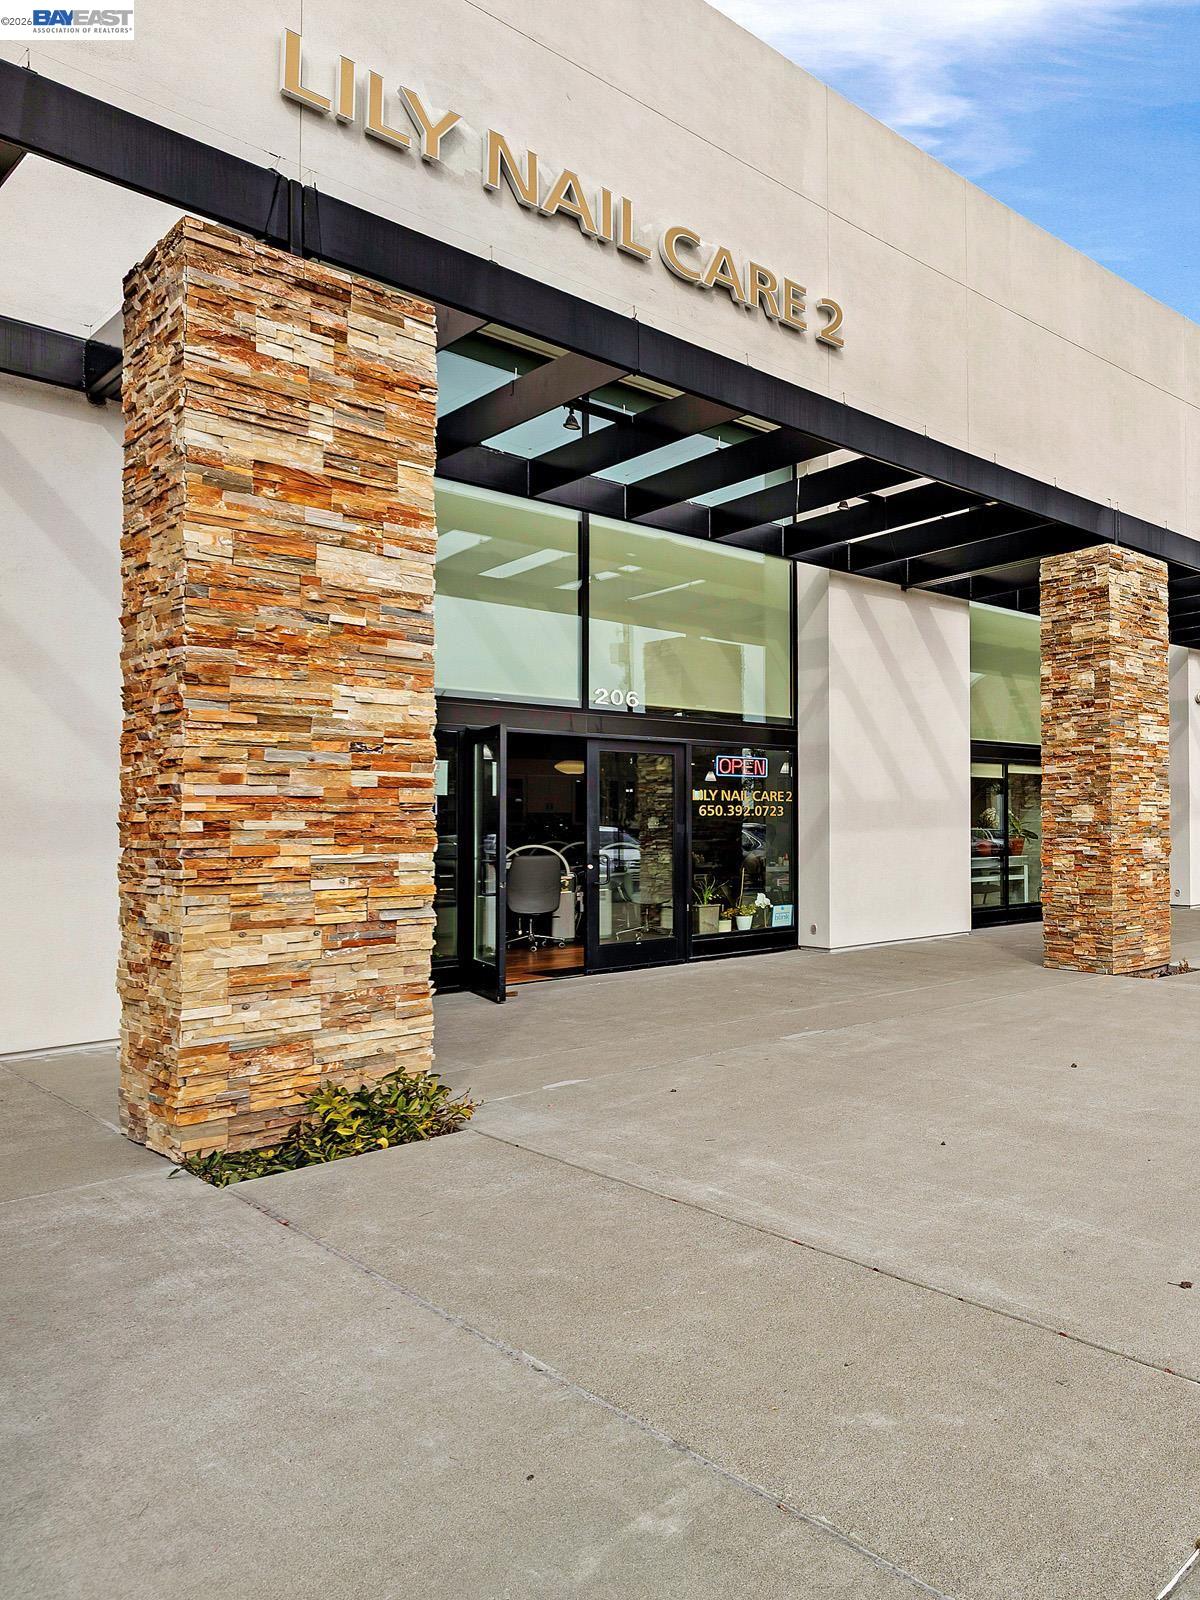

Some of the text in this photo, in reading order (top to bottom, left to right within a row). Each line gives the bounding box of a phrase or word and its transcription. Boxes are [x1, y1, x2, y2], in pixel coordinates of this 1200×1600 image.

[279, 27, 846, 350] LILY NAIL CARE 2
[594, 687, 640, 708] 206
[719, 758, 766, 775] OPEN
[721, 789, 748, 802] NAIL
[752, 790, 785, 802] CARE
[785, 791, 793, 802] 2
[698, 804, 784, 817] 650.392.0723
